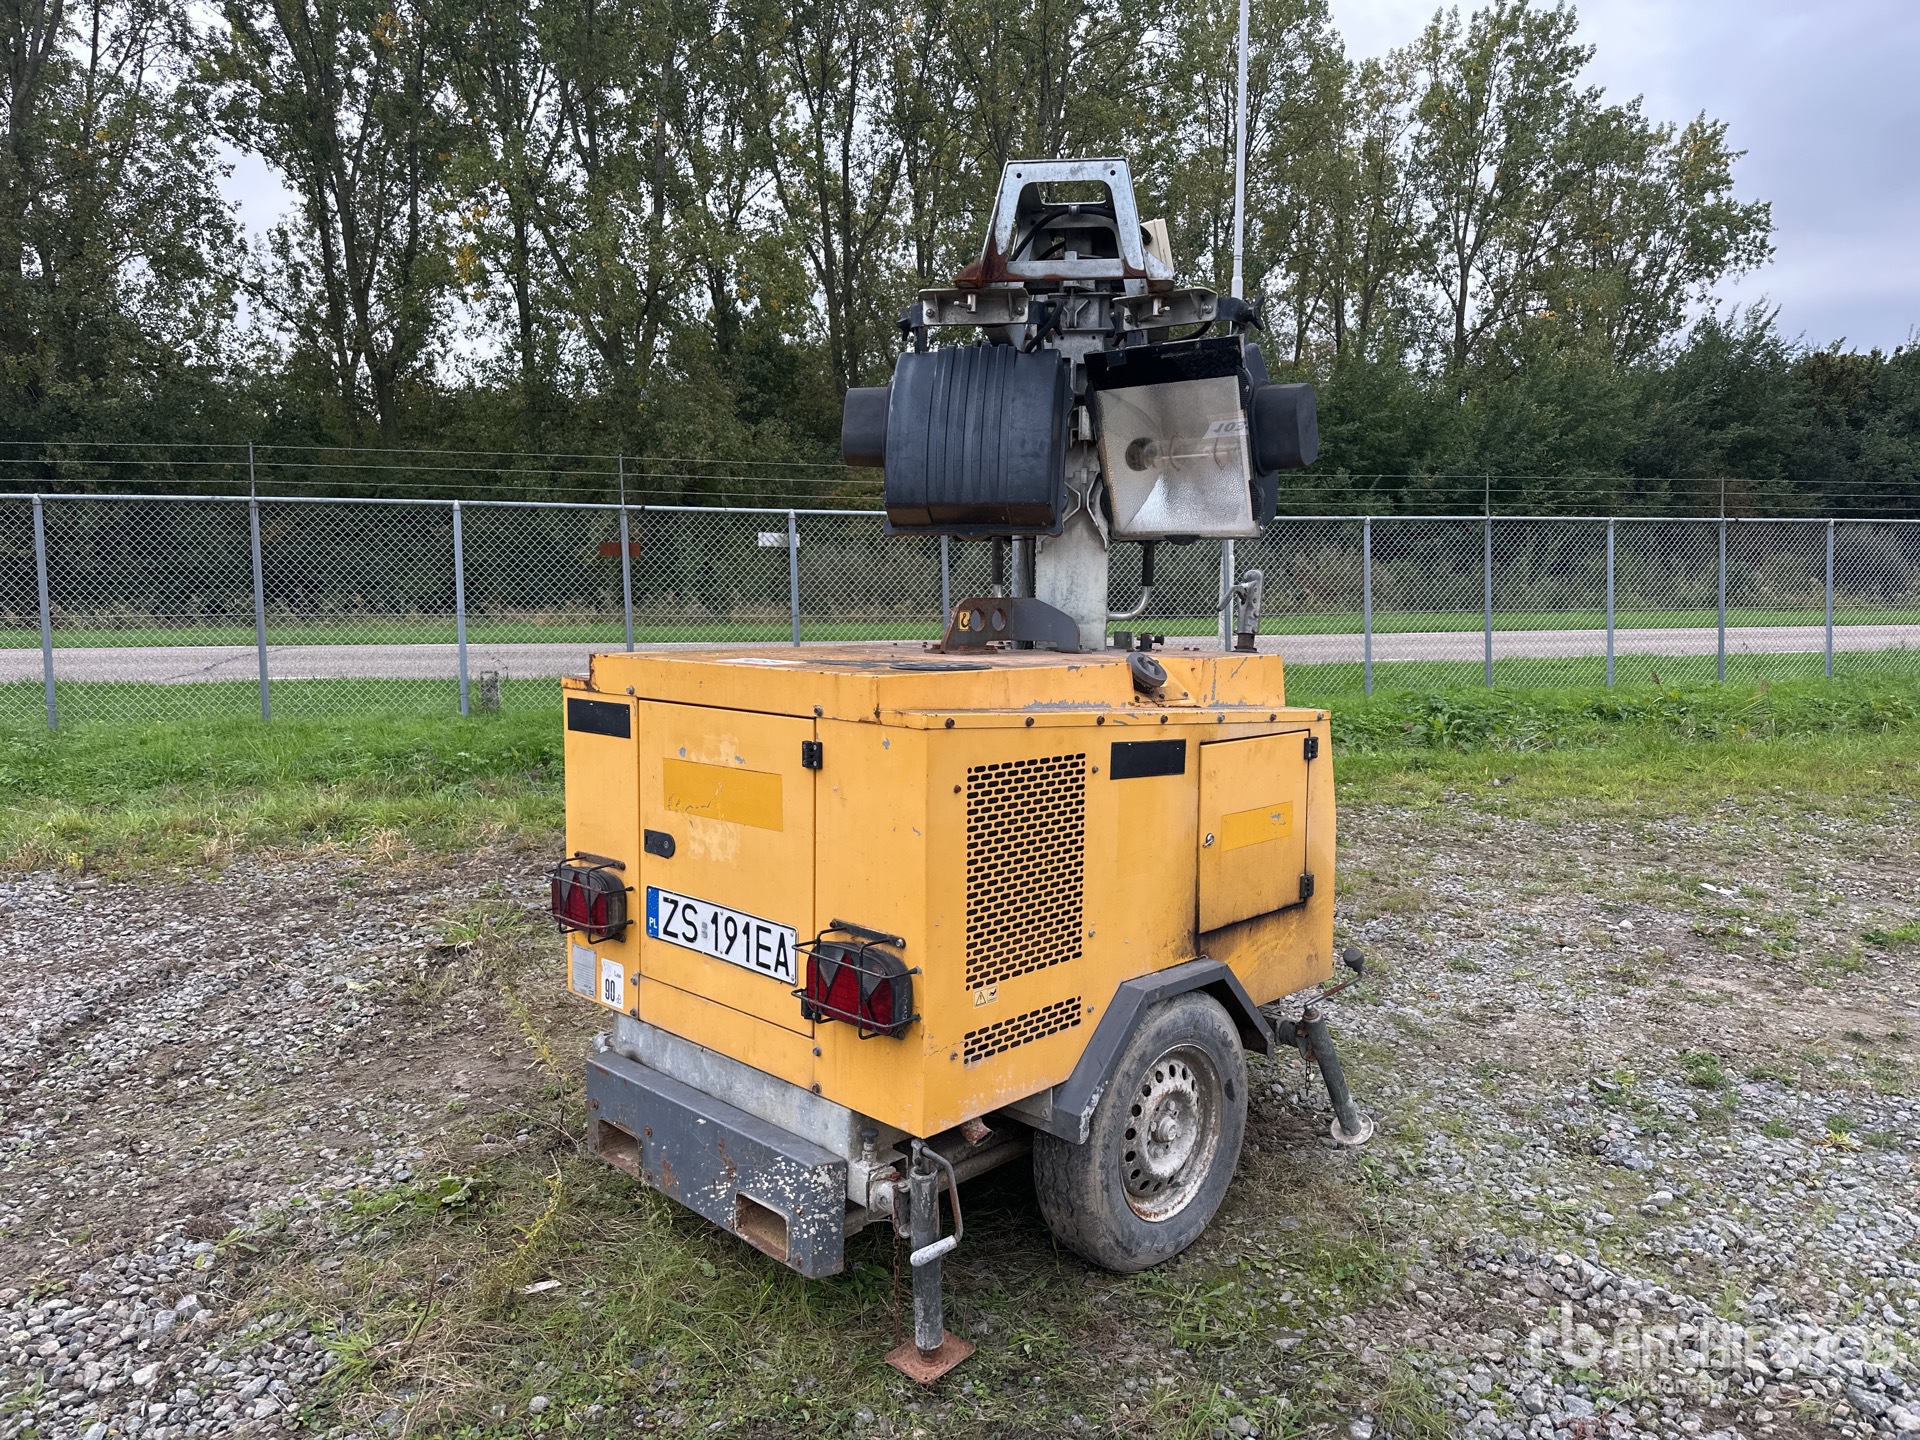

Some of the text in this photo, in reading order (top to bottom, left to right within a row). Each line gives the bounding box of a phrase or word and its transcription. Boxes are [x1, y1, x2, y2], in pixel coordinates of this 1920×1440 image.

[648, 916, 658, 929] PL
[662, 896, 790, 977] ZS 191EA
[604, 978, 616, 1002] 90
